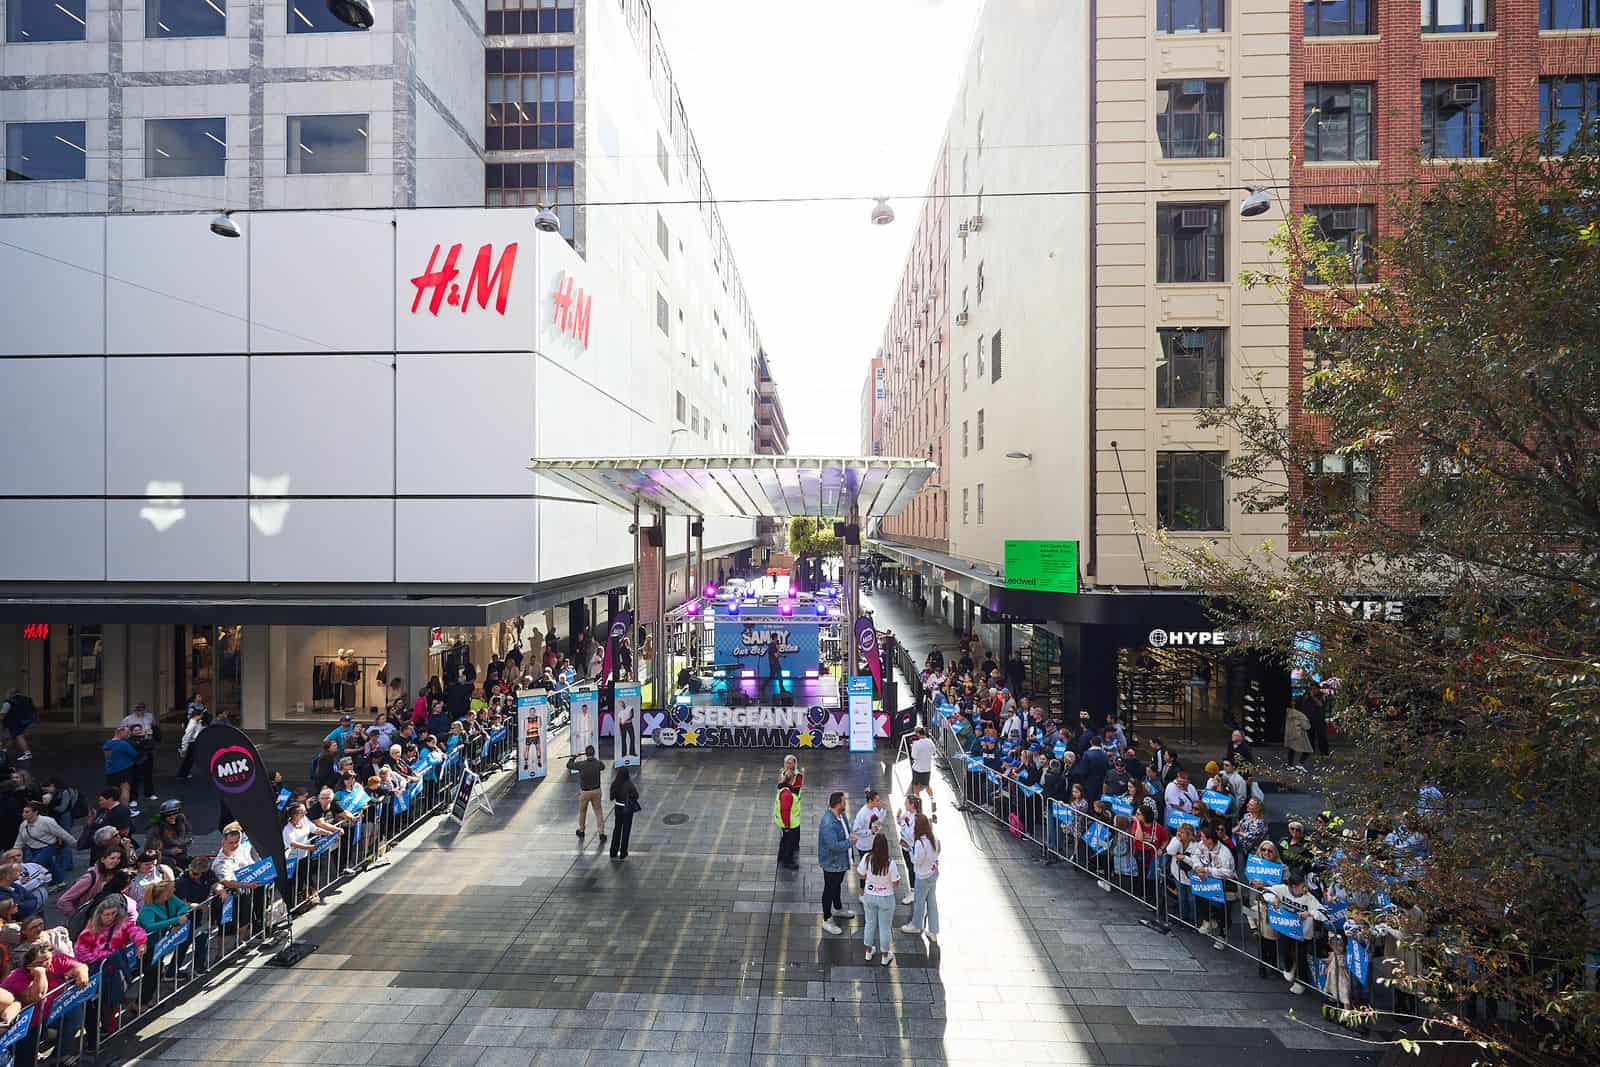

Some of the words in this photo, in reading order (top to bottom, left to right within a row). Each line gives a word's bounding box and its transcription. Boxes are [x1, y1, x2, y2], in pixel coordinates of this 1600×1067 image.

[410, 242, 518, 317] H&M
[552, 270, 592, 351] H&M
[1169, 631, 1225, 646] HYPE
[691, 706, 808, 728] SERGEANT
[703, 727, 794, 748] SAMMY
[217, 758, 250, 778] MIX
